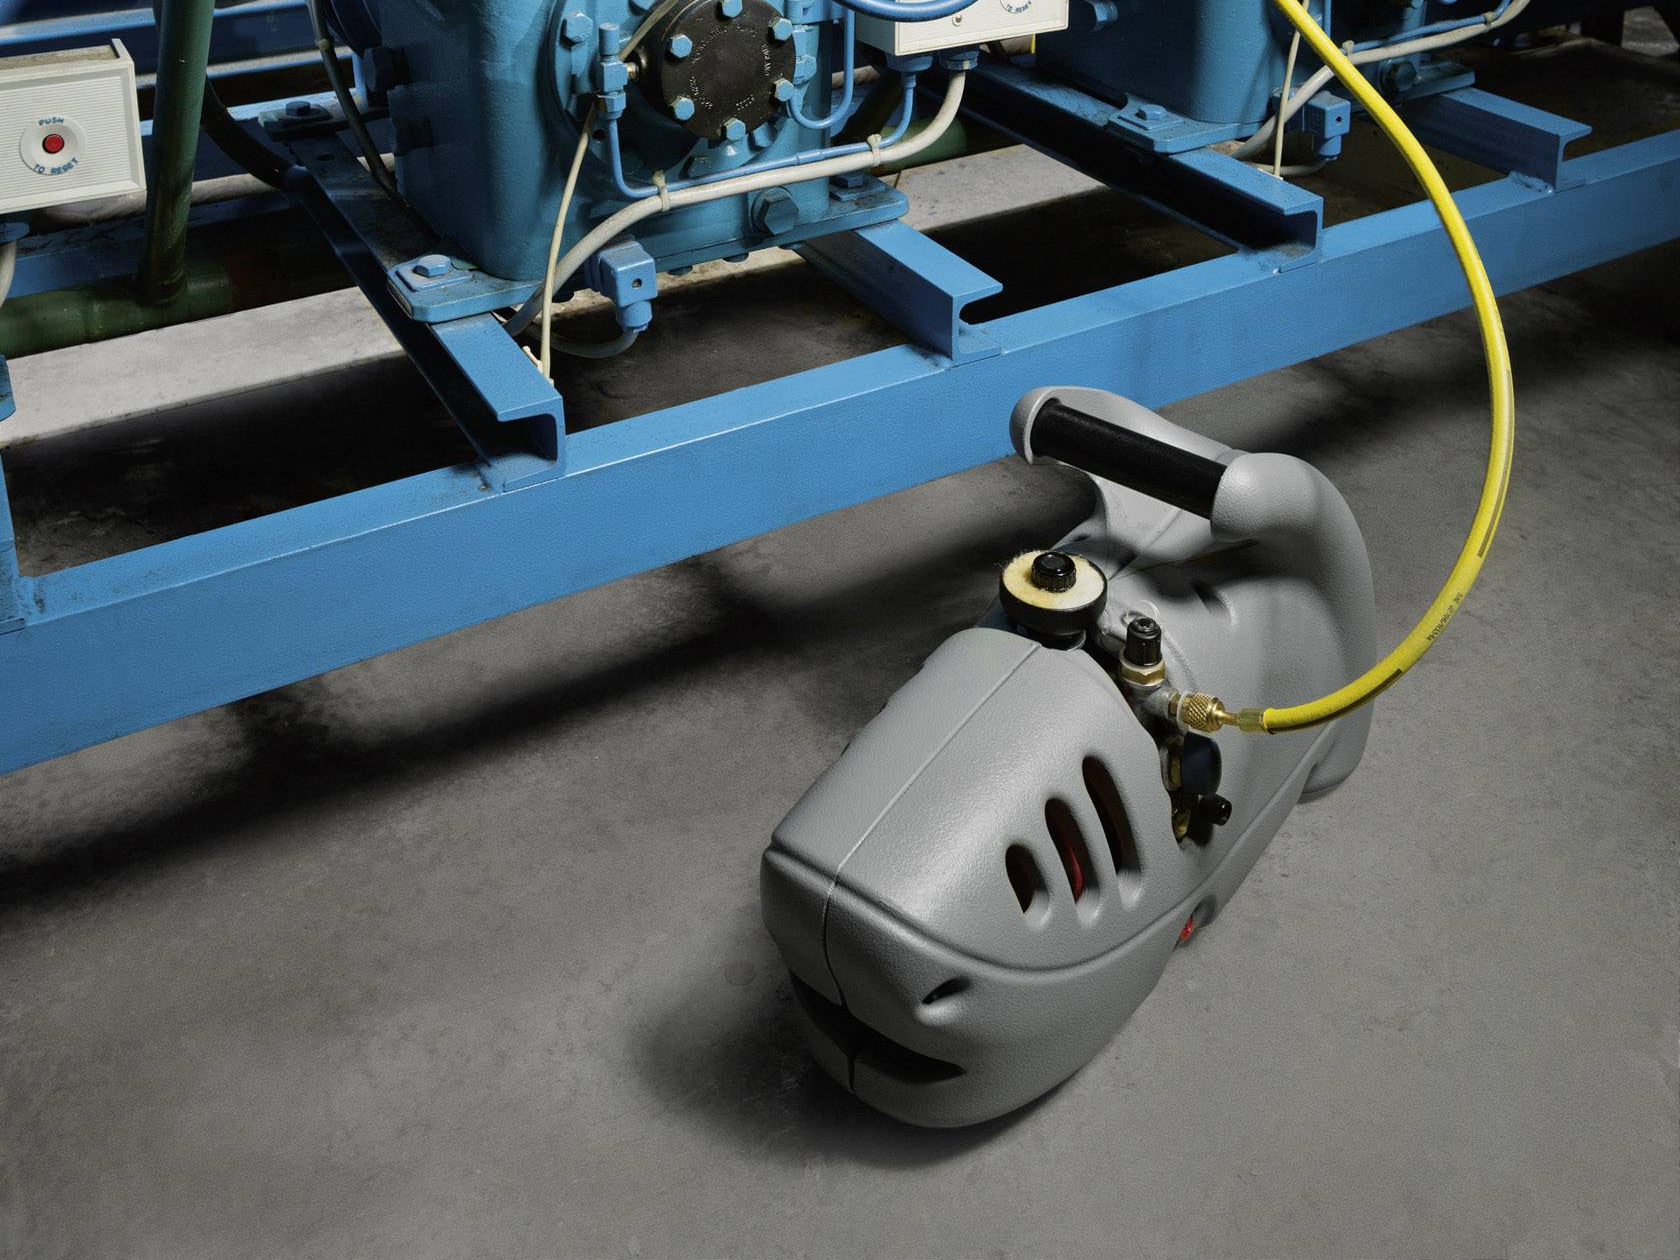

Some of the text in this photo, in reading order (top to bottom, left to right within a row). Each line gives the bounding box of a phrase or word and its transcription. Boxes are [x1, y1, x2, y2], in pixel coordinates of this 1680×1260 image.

[38, 116, 65, 126] PUSH
[34, 157, 78, 175] TO RESET
